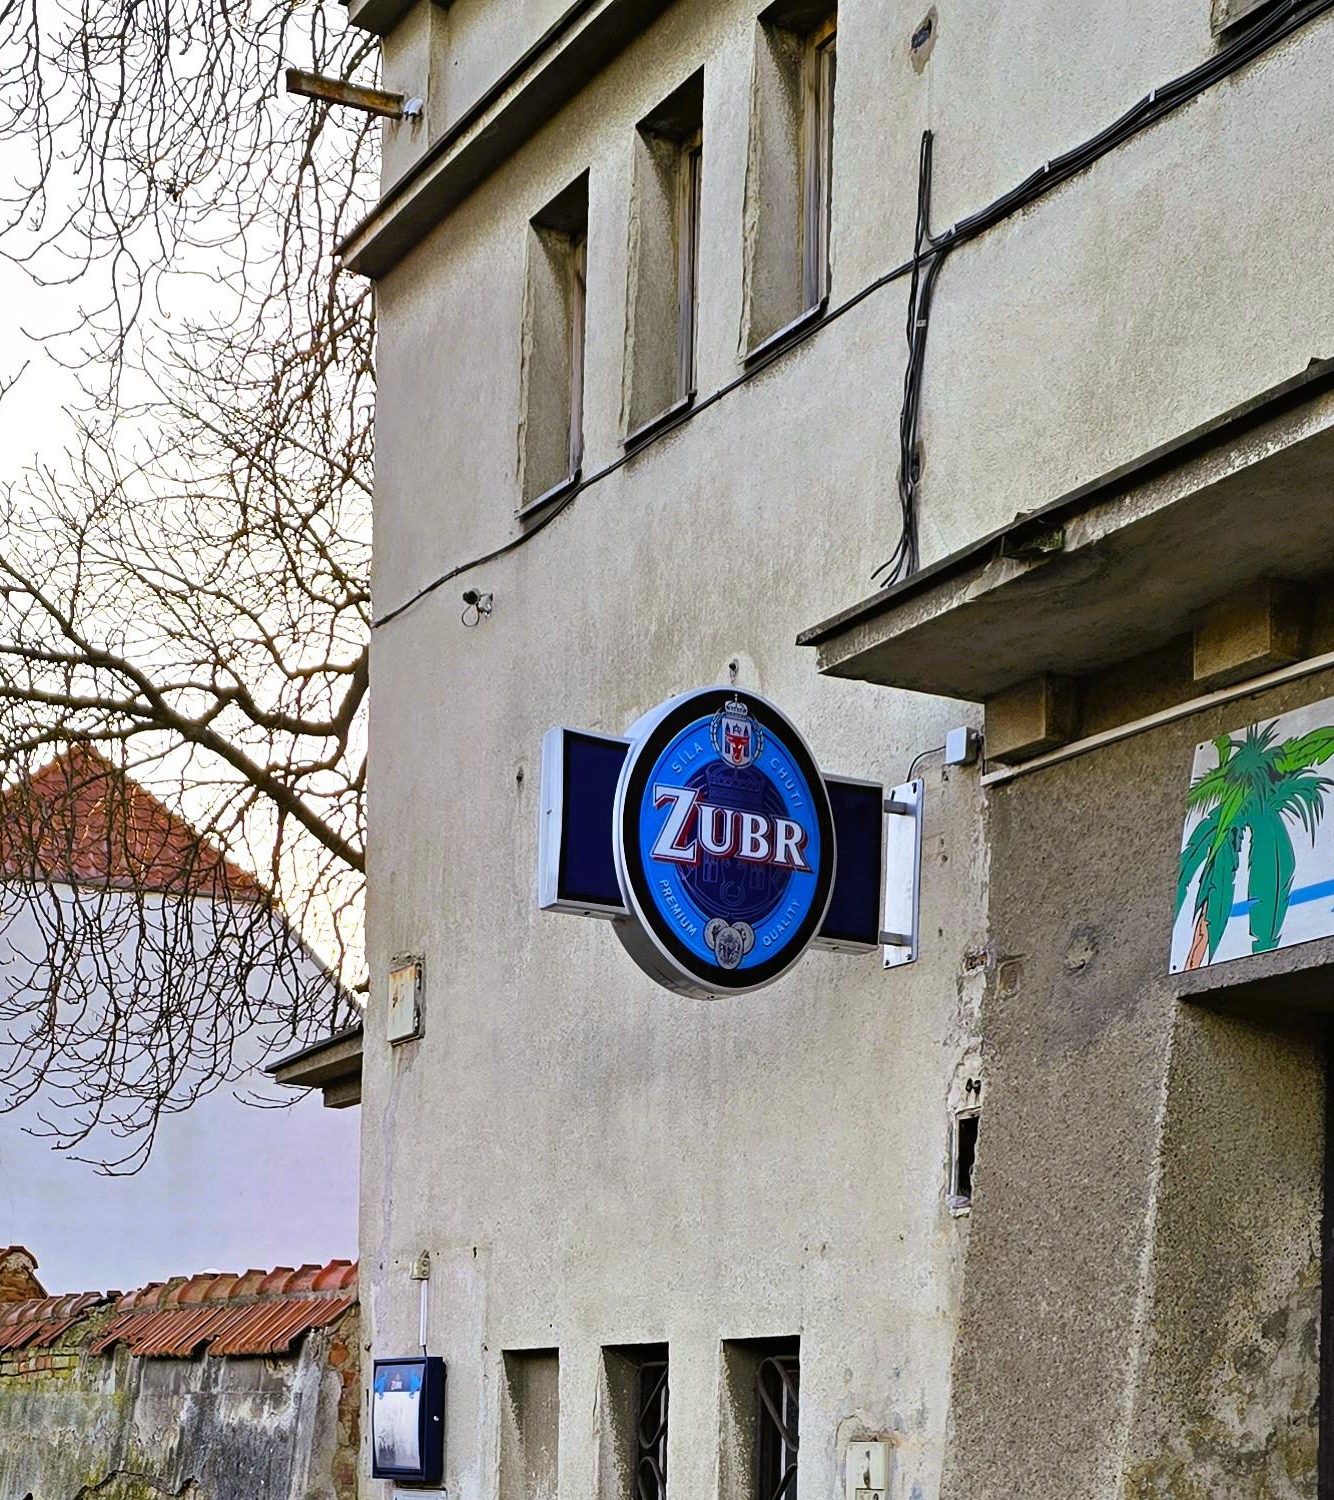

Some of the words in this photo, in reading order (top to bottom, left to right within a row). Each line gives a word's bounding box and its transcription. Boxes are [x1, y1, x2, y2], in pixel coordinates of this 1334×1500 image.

[770, 757, 803, 809] CHUTI
[652, 783, 814, 874] ZUBR
[659, 879, 698, 937] PREMIUM
[761, 898, 801, 946] QUALITY
